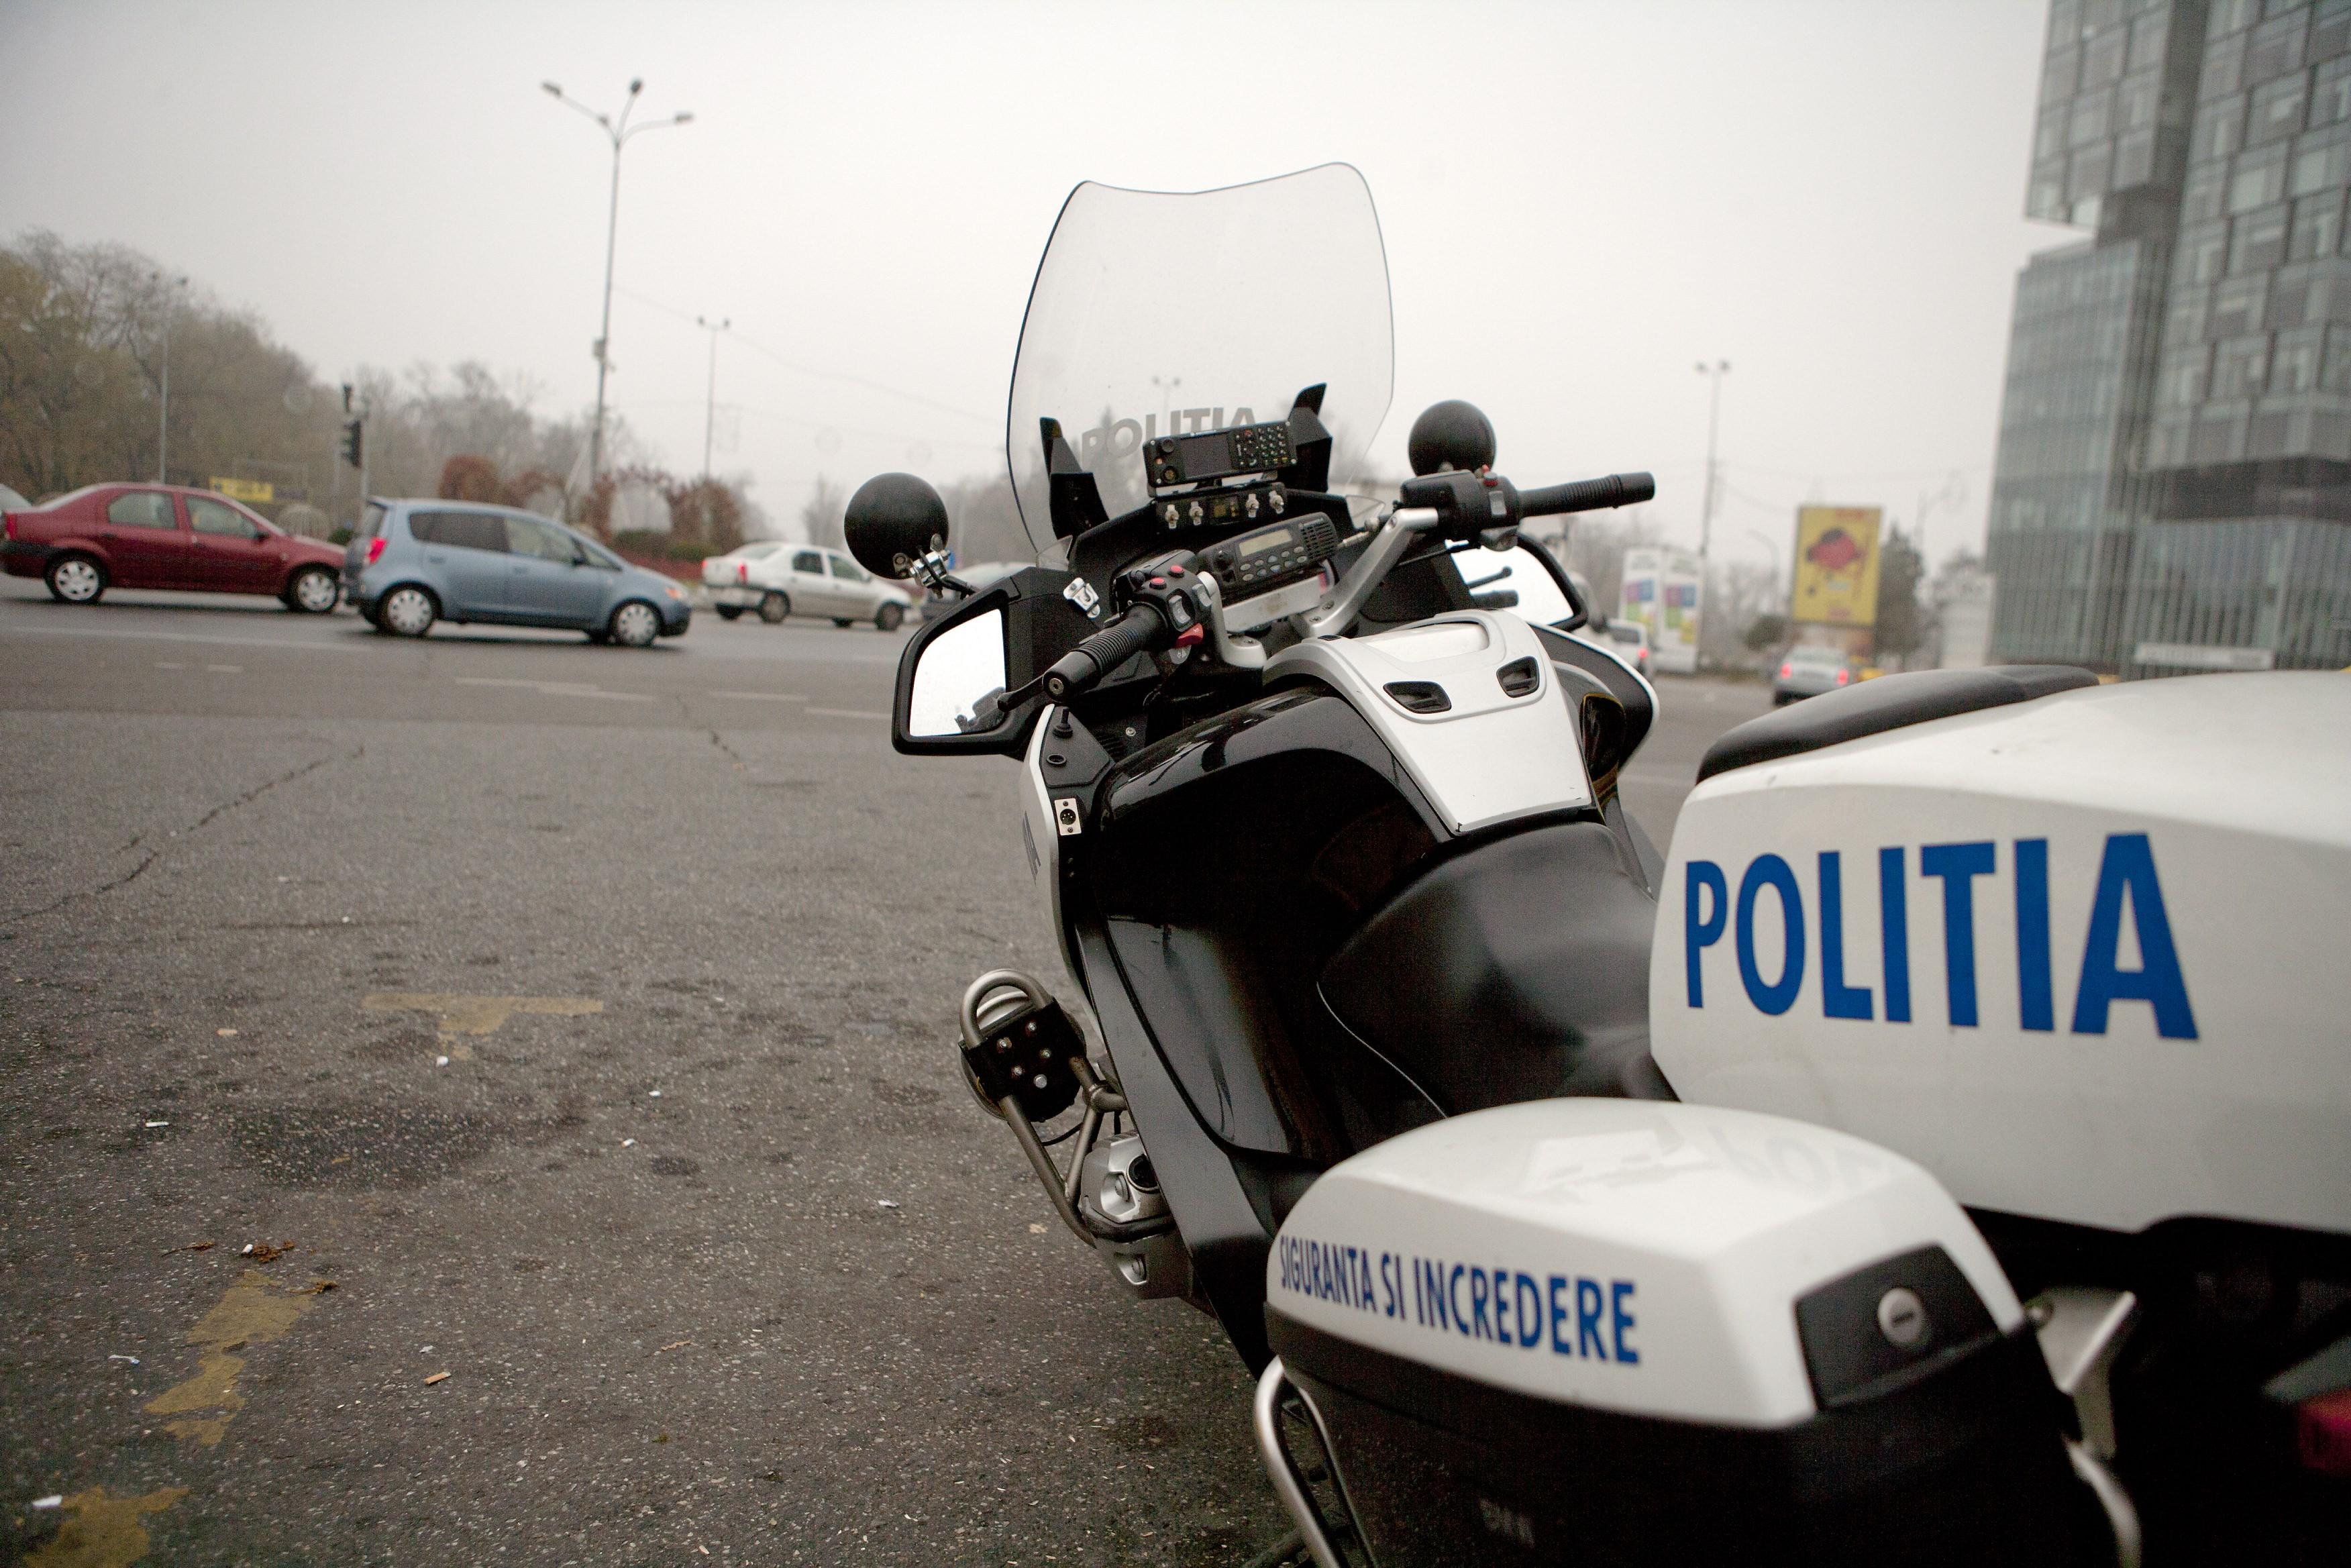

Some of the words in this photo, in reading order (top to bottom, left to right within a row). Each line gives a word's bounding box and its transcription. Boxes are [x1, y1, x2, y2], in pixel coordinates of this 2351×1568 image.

[1685, 831, 2199, 1041] POLITIA
[1280, 1235, 1377, 1313] SIGURANTA
[1381, 1252, 1405, 1320] SI
[1414, 1257, 1638, 1364] INCREDERE
